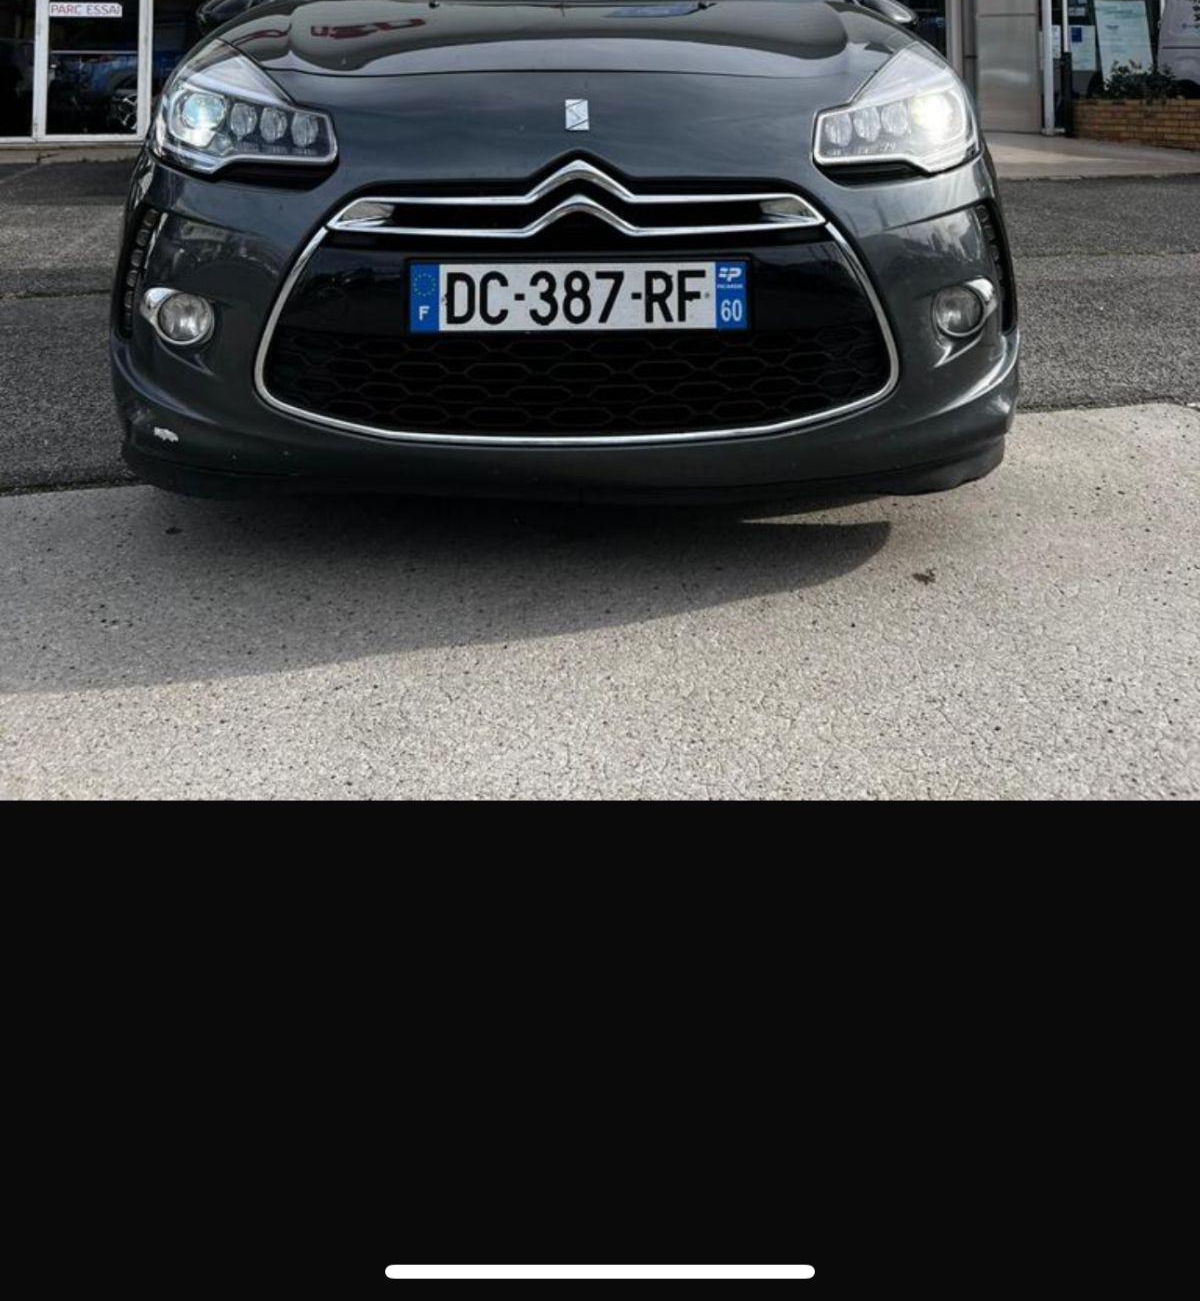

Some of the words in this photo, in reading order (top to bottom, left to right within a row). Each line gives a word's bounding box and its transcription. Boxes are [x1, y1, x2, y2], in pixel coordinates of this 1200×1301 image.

[51, 4, 82, 14] PARC
[86, 4, 120, 15] ESSAI
[445, 269, 706, 326] DC-387-RF
[418, 306, 430, 321] F
[720, 299, 743, 322] 60
